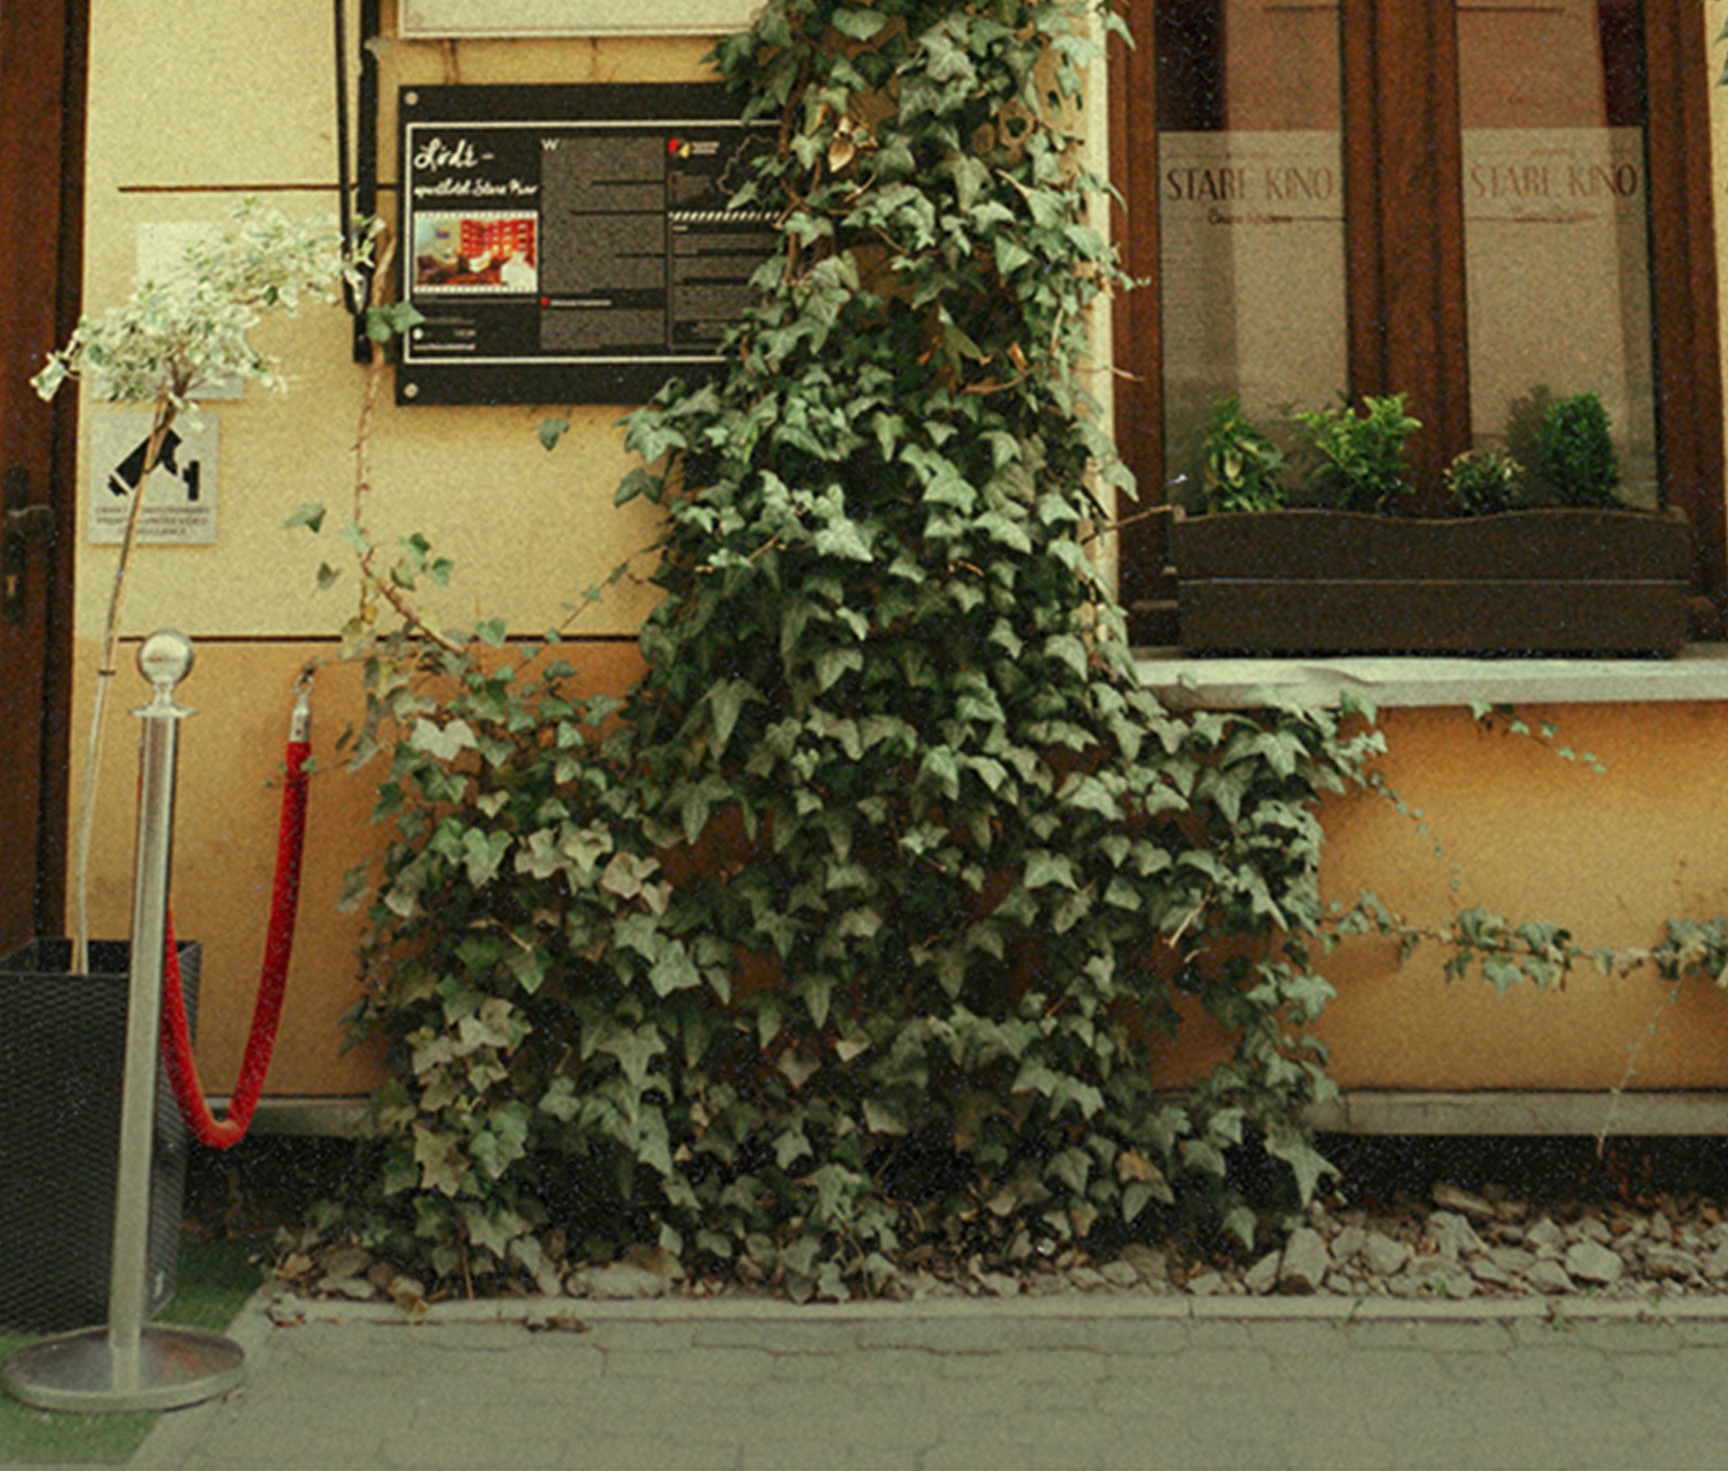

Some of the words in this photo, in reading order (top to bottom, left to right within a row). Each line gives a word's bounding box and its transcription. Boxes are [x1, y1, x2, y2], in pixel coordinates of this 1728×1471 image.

[1166, 166, 1250, 200] STARE
[1265, 166, 1333, 199] KINO
[1471, 163, 1552, 198] STARE
[1569, 162, 1637, 197] KINO
